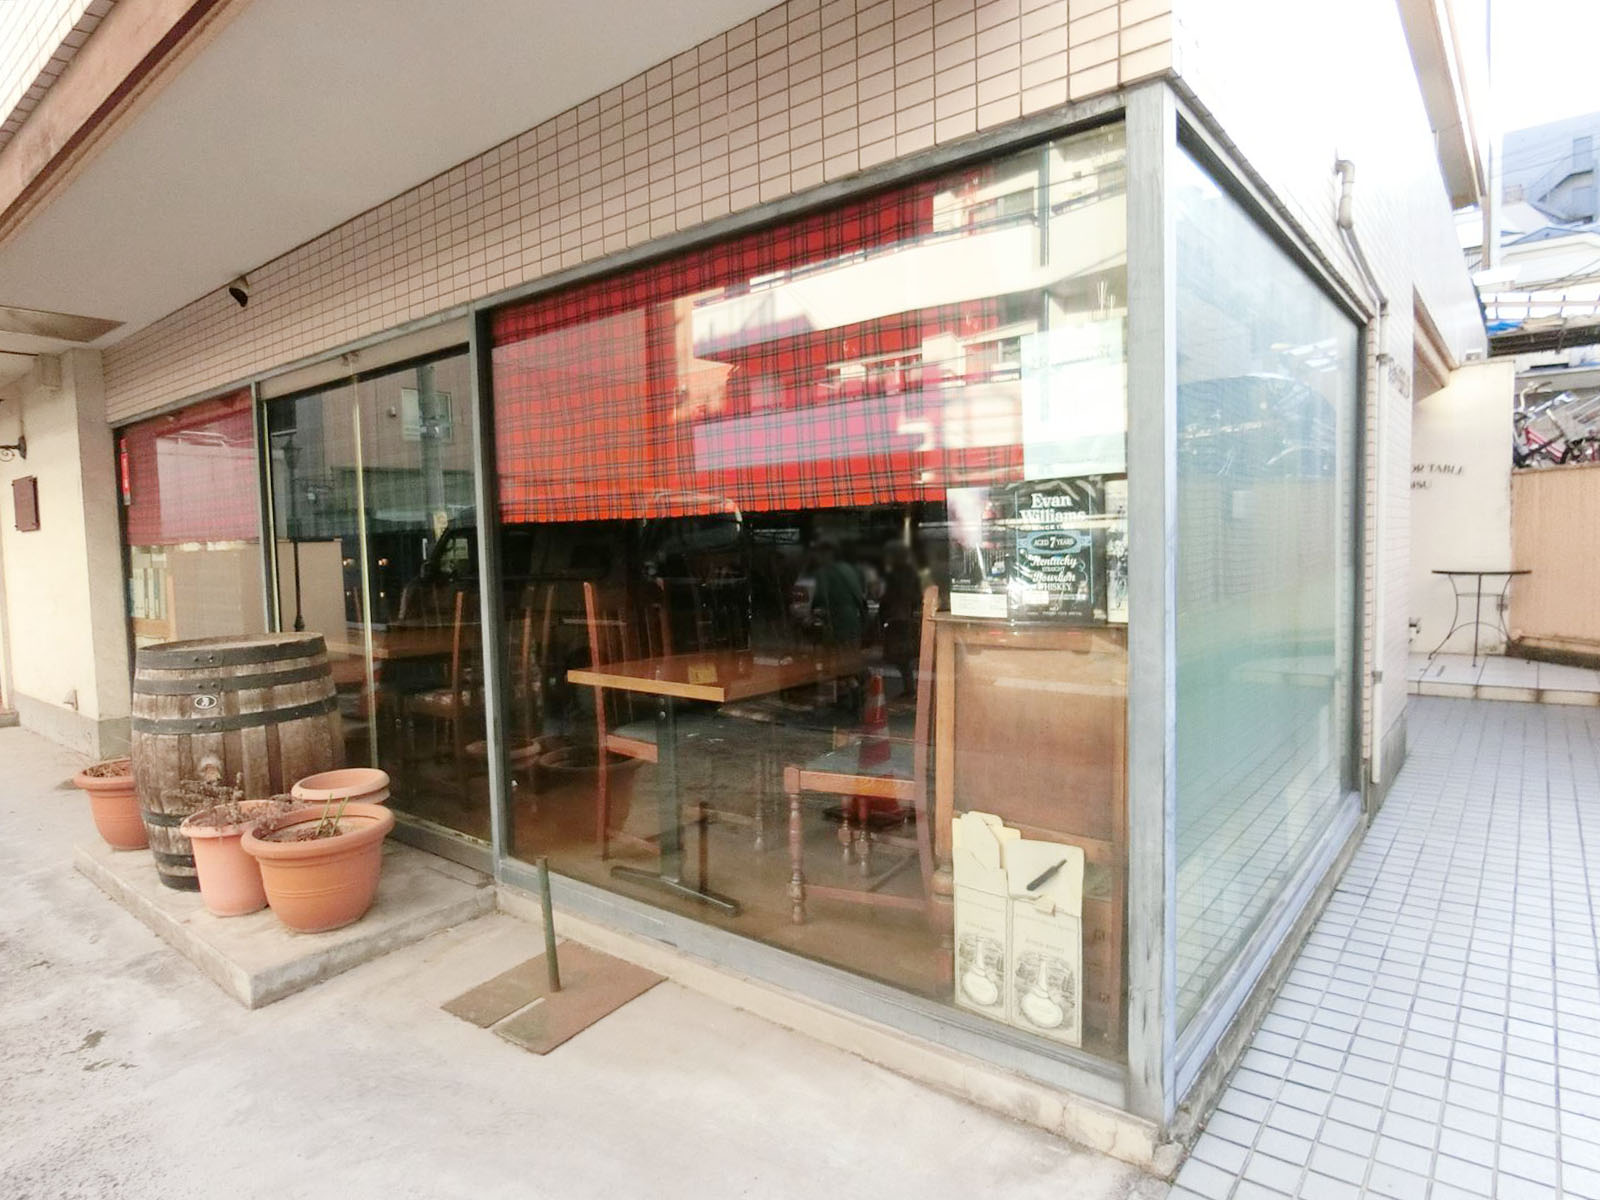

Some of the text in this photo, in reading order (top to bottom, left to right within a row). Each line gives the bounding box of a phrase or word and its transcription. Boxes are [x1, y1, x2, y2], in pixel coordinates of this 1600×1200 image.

[1031, 493, 1073, 508] Evan
[1019, 509, 1087, 523] Williams
[1049, 537, 1056, 548] 7
[1030, 554, 1077, 568] Kentucky
[1033, 570, 1076, 582] Bourbon
[1037, 583, 1071, 592] WHISKEY
